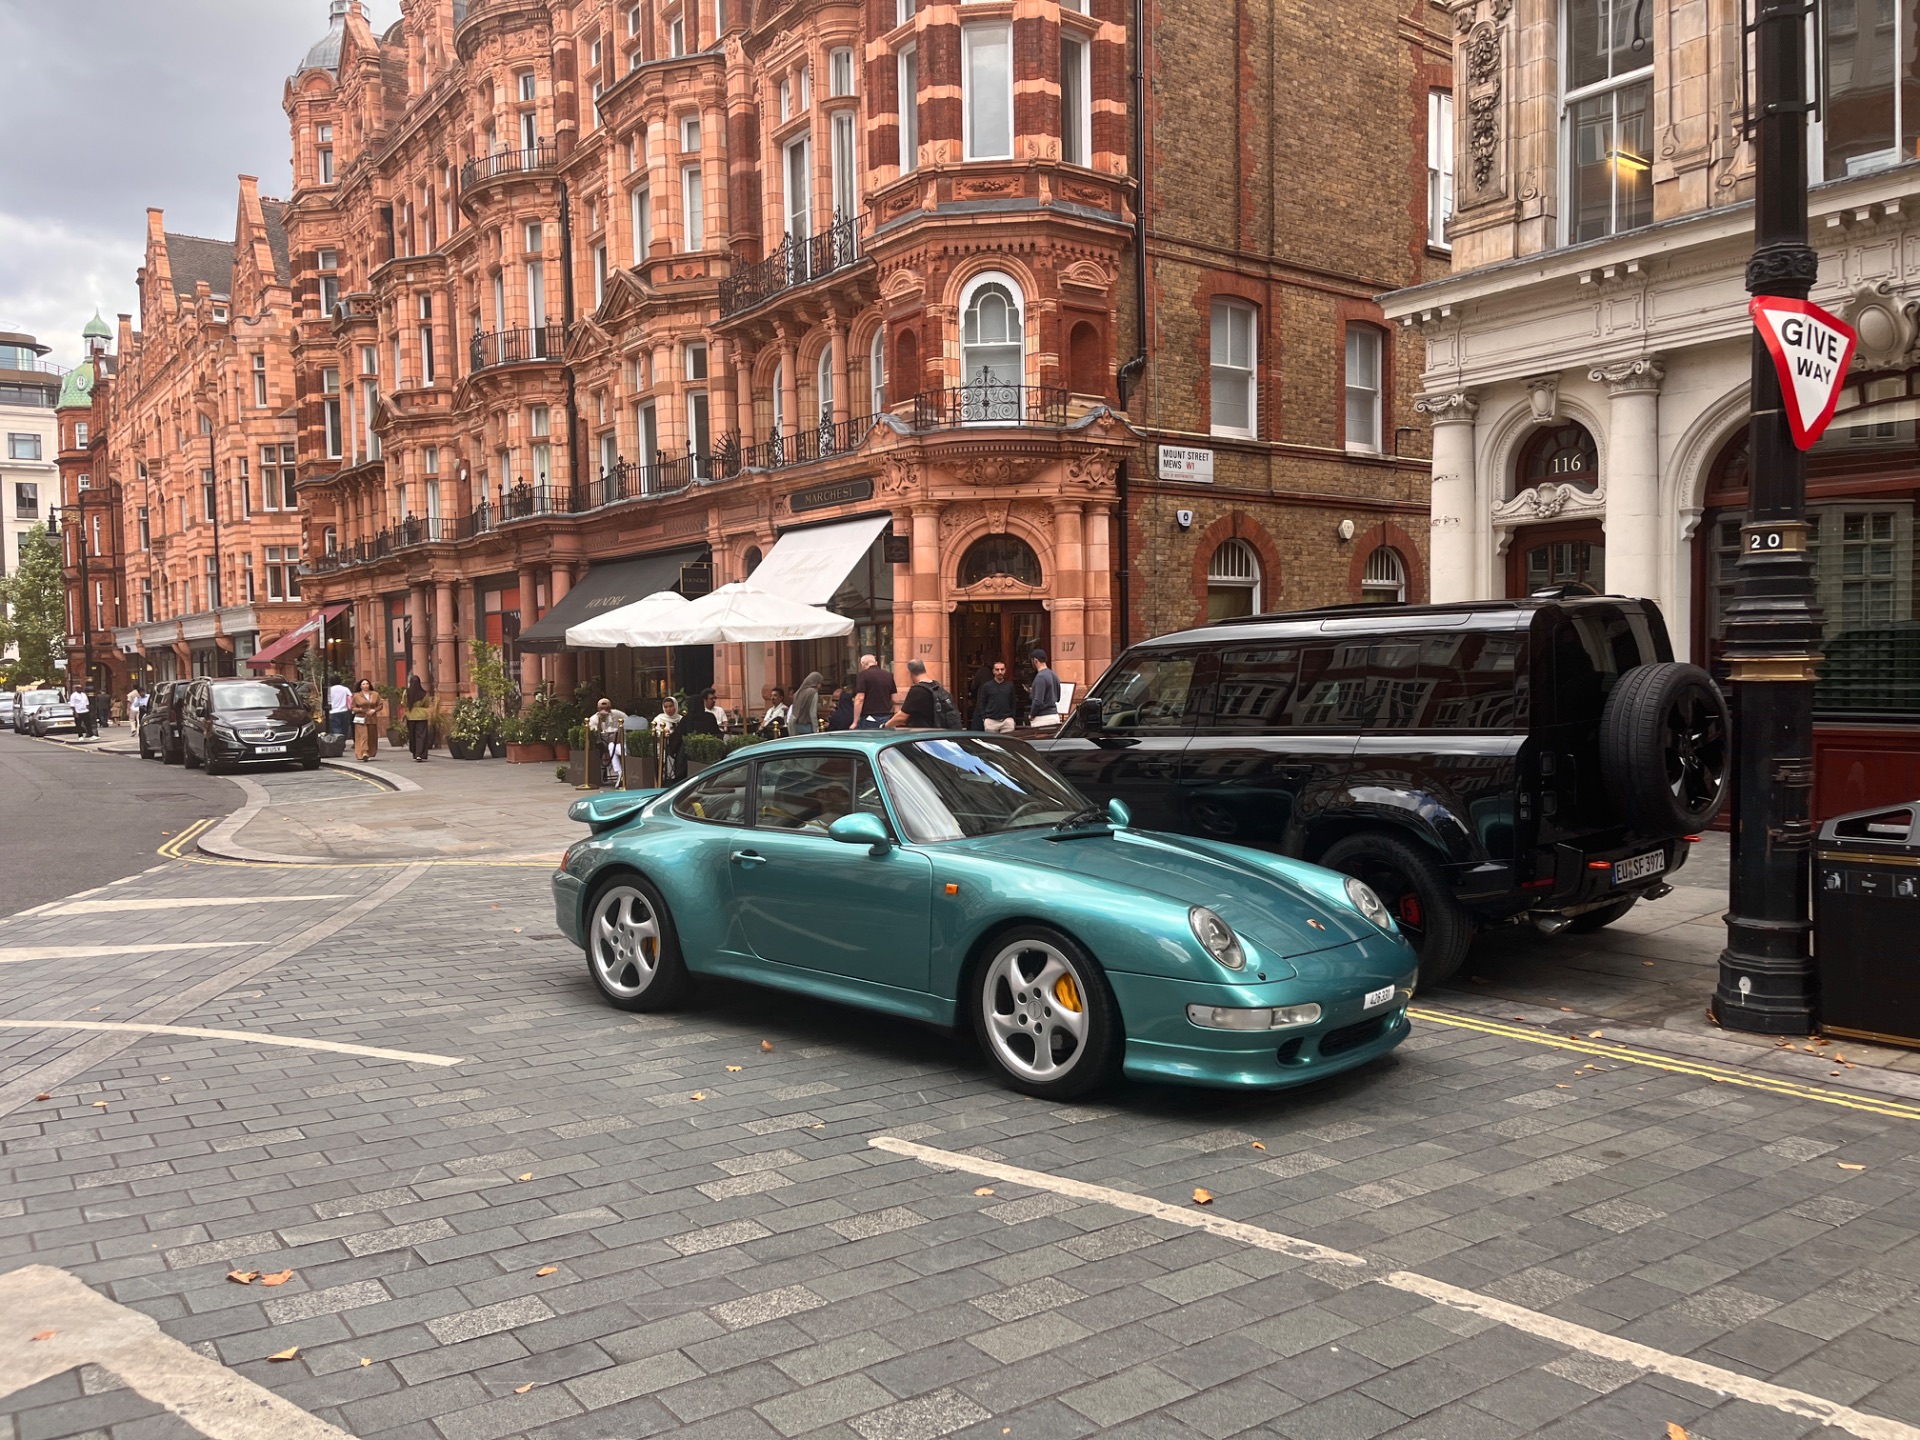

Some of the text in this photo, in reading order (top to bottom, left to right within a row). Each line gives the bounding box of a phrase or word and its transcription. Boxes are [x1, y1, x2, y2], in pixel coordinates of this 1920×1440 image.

[1781, 318, 1838, 363] GIVE
[1797, 356, 1831, 385] WAY
[1163, 449, 1209, 462] MOUNT STREET
[1163, 459, 1195, 471] MEWS W1
[1553, 453, 1581, 474] 116
[805, 486, 853, 505] MARCHESI
[919, 643, 934, 654] 117
[1061, 641, 1076, 652] 117
[1616, 852, 1664, 881] EU SF 3972
